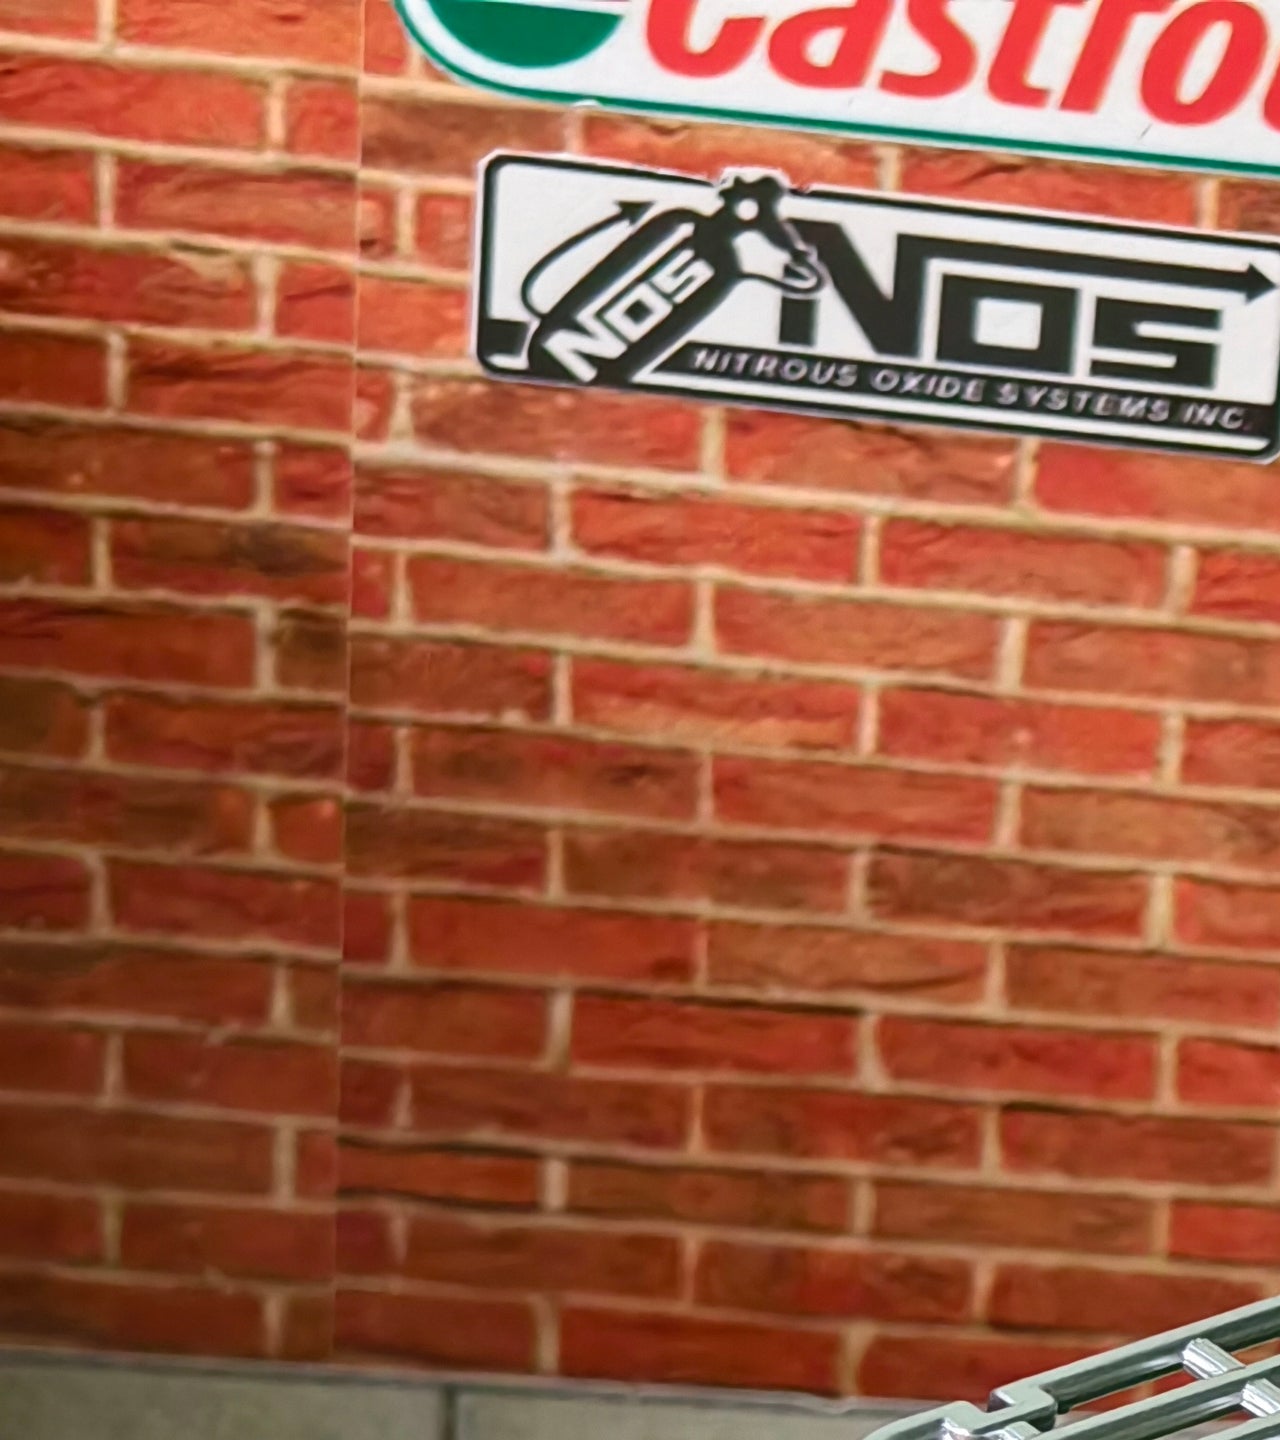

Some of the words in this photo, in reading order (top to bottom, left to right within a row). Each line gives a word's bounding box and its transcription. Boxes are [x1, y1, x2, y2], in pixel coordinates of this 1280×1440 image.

[544, 248, 715, 383] NOS
[780, 217, 1220, 391] NOS
[693, 349, 858, 387] NITROUS
[869, 367, 984, 403] OXIDE
[998, 382, 1170, 423] SYSTEMS
